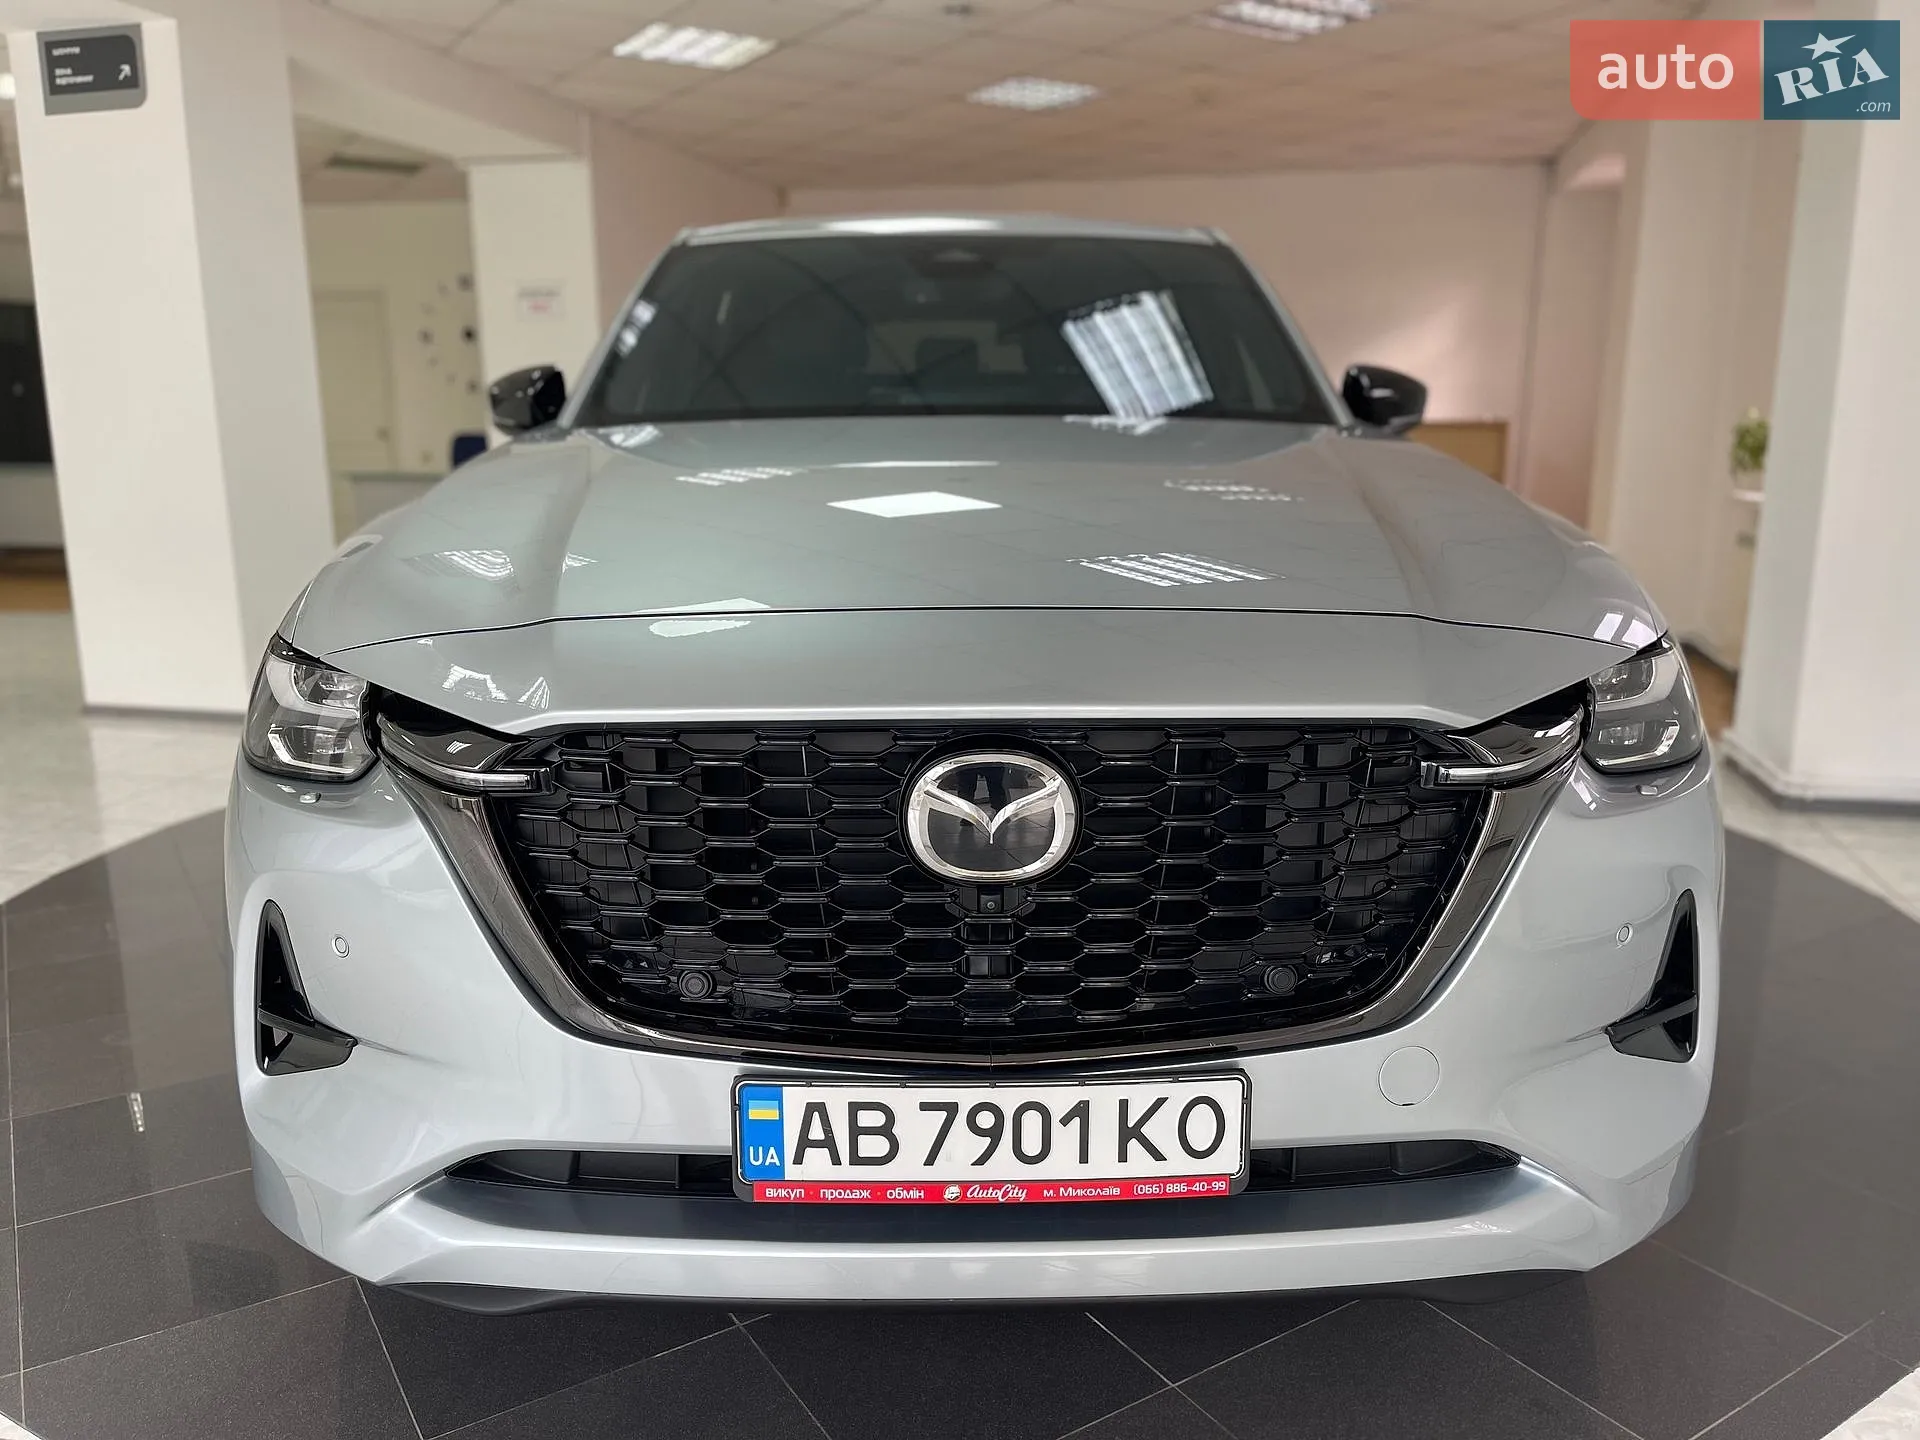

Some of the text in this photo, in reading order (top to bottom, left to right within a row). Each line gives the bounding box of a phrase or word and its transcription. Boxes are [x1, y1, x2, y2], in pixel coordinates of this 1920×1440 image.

[792, 1095, 1226, 1167] AB 7901 KO
[749, 1146, 781, 1166] UA
[765, 1187, 925, 1201] викуп продаж обмін
[1043, 1186, 1121, 1198] м. Миколаїв
[1133, 1181, 1226, 1195] (066) 886-40-99
